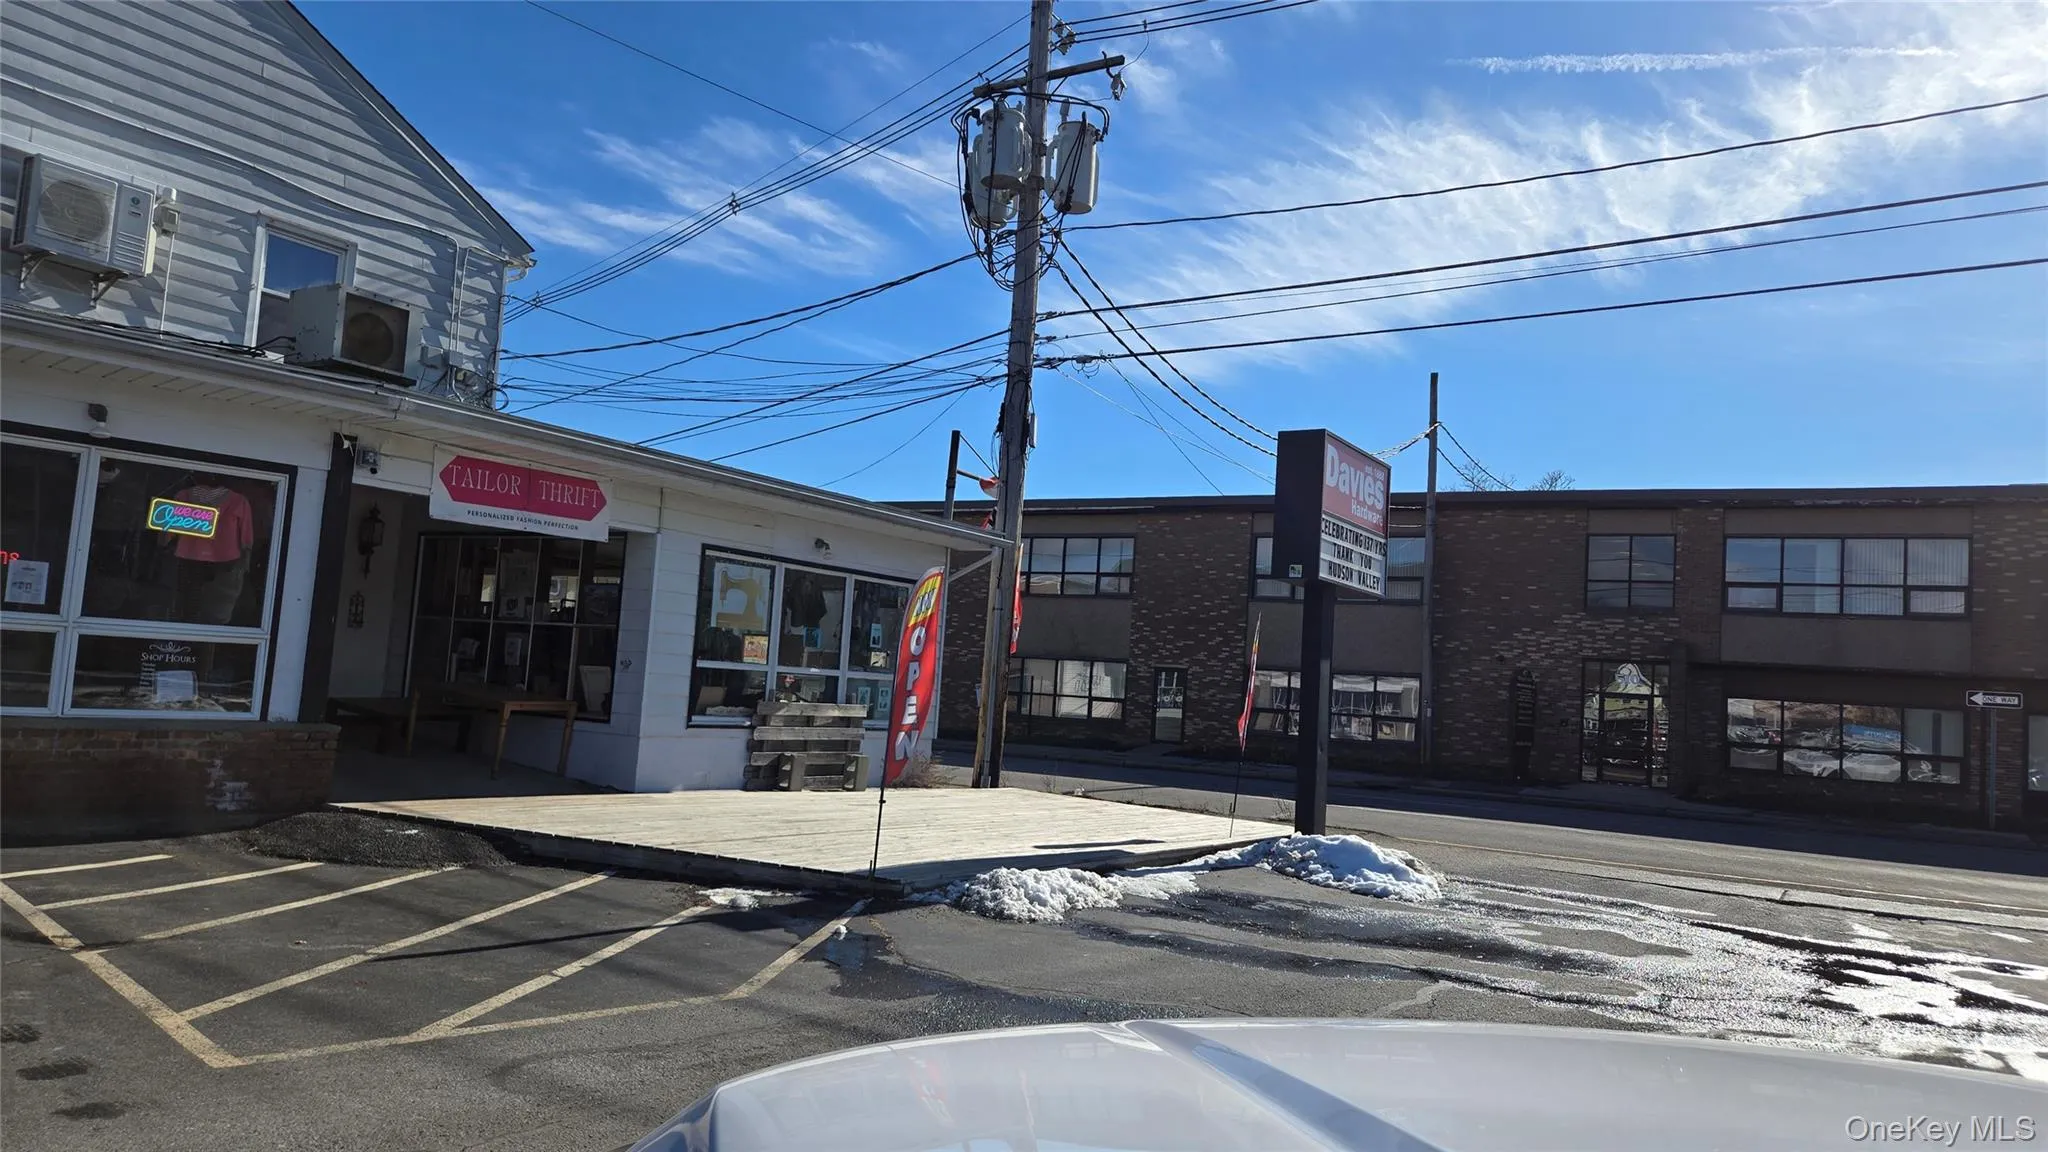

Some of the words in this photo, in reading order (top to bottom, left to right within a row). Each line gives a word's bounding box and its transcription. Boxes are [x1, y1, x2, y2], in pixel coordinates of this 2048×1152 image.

[449, 464, 521, 496] TAILOR
[538, 479, 600, 508] THRIFT
[1326, 444, 1384, 509] Davies
[153, 504, 212, 532] Open
[467, 509, 515, 521] PERSONALIZED
[516, 516, 543, 526] FASHION
[543, 520, 579, 531] PERFECTION
[1351, 498, 1383, 527] Hardware
[1334, 543, 1353, 564] THANK
[1360, 552, 1372, 570] YOU
[1374, 539, 1387, 557] YRS
[1328, 560, 1353, 583] HUDSON
[1358, 570, 1380, 591] VALLEY
[894, 625, 927, 761] OPEN
